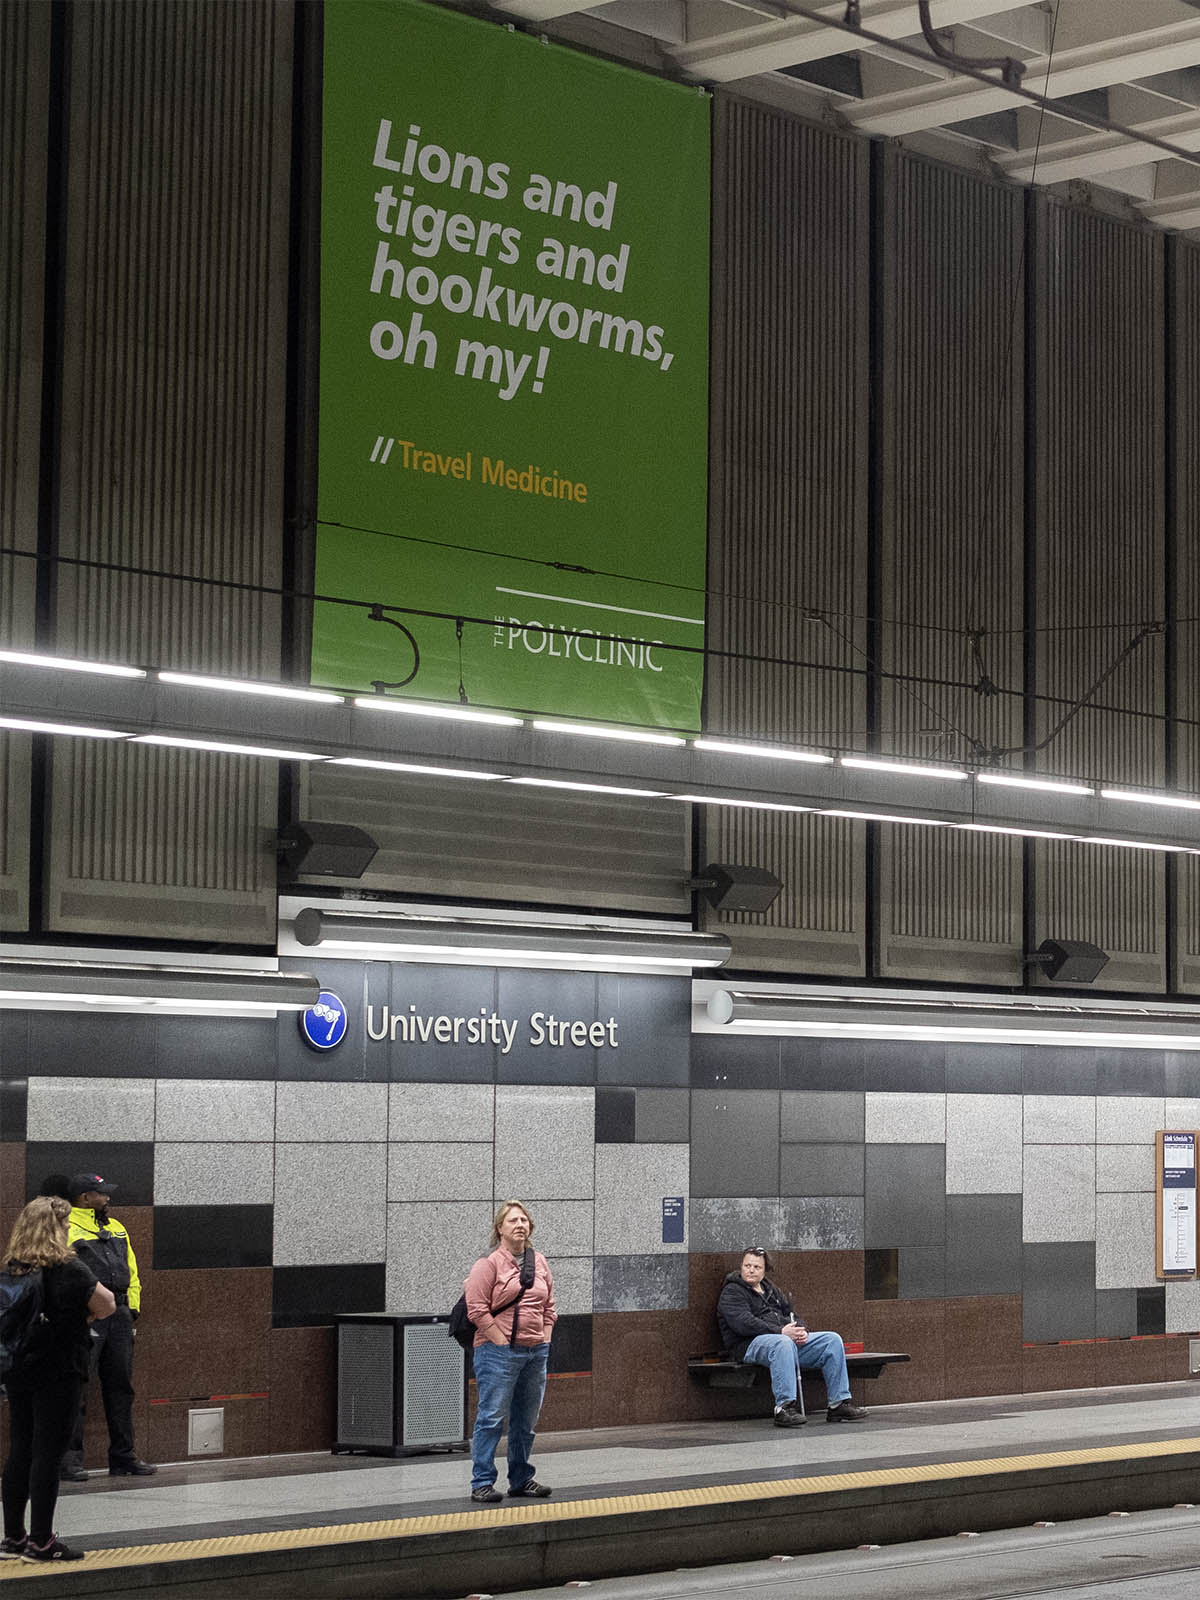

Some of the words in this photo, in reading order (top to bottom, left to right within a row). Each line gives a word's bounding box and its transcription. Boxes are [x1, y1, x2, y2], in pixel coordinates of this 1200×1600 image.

[372, 118, 510, 200] Lions
[523, 174, 618, 231] and
[374, 185, 521, 265] tigers
[536, 238, 630, 293] and
[369, 240, 674, 371] hookworms,
[369, 312, 438, 369] oh
[454, 338, 550, 402] my!
[481, 456, 588, 503] Medicine
[508, 616, 664, 672] POLYCLINIC
[367, 1004, 518, 1055] University
[529, 1011, 619, 1048] Street
